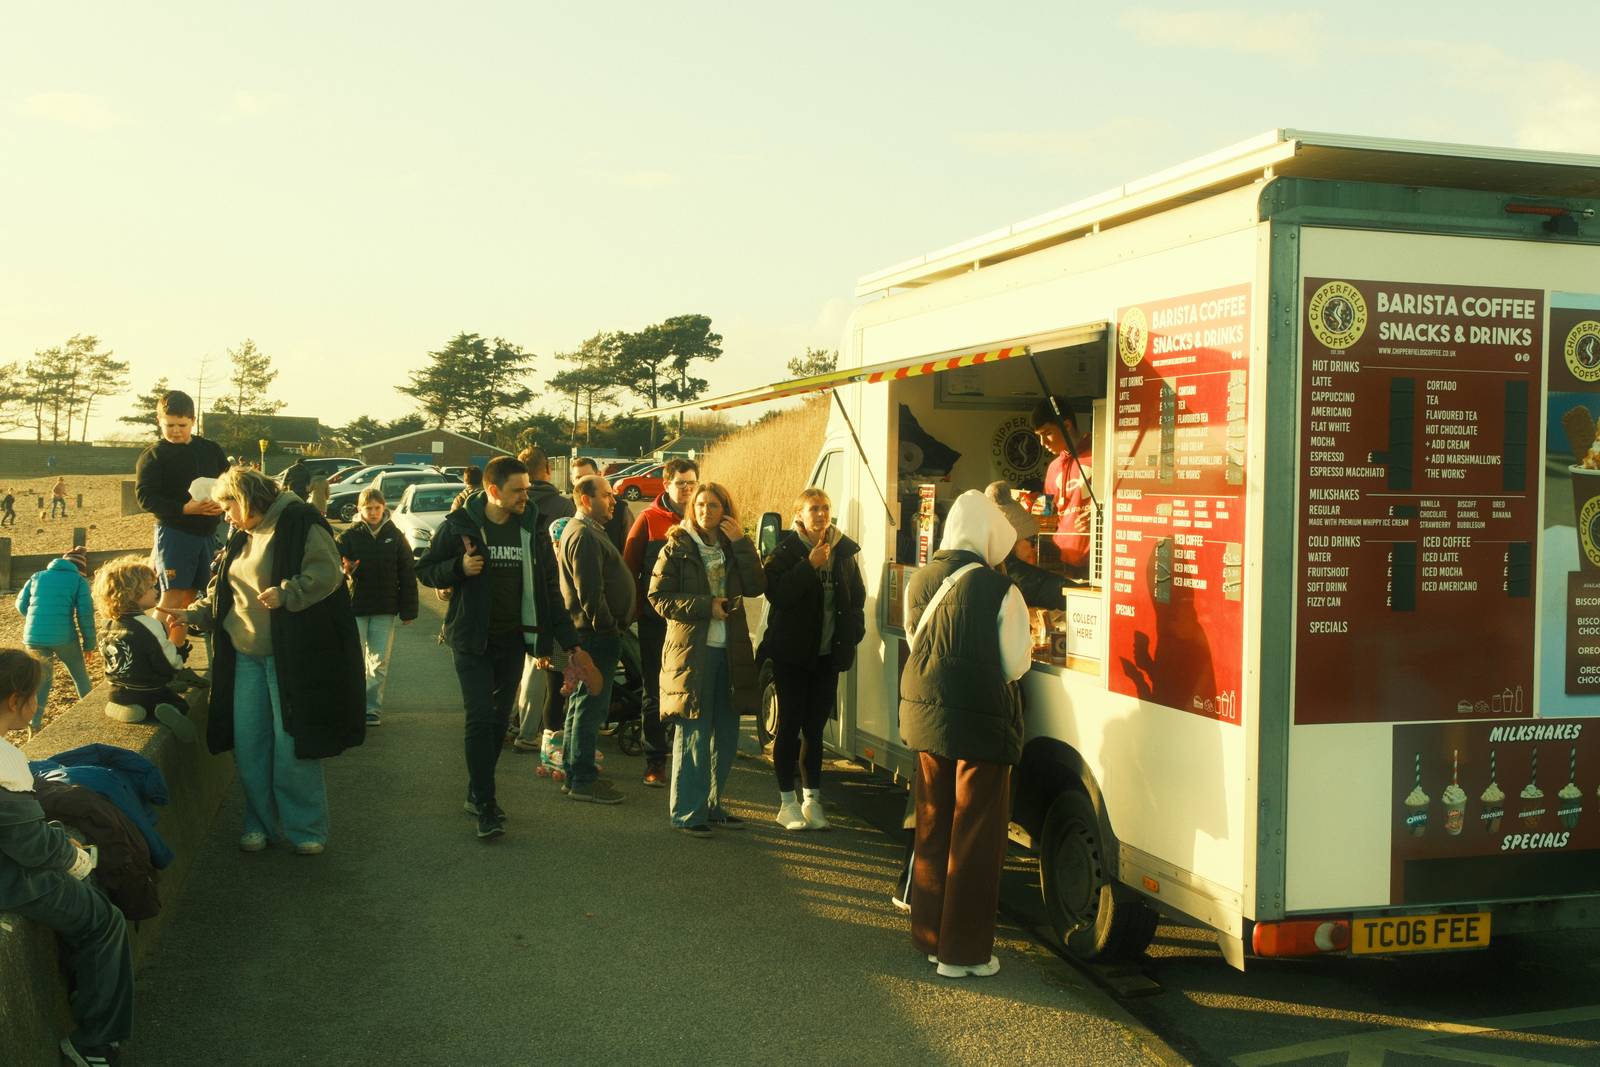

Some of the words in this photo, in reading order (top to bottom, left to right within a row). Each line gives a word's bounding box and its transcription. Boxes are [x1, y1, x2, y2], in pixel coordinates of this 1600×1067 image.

[1377, 292, 1458, 316] BARISTA
[1462, 298, 1535, 320] COFFEE
[1152, 304, 1198, 329] BARISTA
[1199, 295, 1246, 320] COFFEE
[1153, 332, 1193, 354] SNACKS
[1194, 331, 1201, 347] &
[1204, 325, 1244, 347] DRINKS
[1319, 331, 1356, 346] COFFEE
[1379, 322, 1450, 343] SNACKS
[1454, 324, 1466, 343] &
[1470, 326, 1532, 346] DRINKS
[1312, 360, 1328, 371] HOT
[1330, 361, 1360, 372] DRINKS
[1312, 376, 1332, 387] LATTE
[1426, 380, 1456, 391] CORTADO
[1312, 391, 1355, 403] CAPPUCCINO
[1426, 395, 1439, 405] TEA
[1311, 407, 1352, 418] AMERICANO
[1426, 410, 1463, 420] FLAVOURED
[1465, 411, 1478, 421] TEA
[1311, 422, 1325, 432] FLAT
[1327, 422, 1350, 432] WHITE
[1426, 425, 1439, 435] HOT
[1440, 425, 1478, 436] CHOCOLATE
[1310, 437, 1335, 447] MOCHA
[1432, 440, 1445, 449] ADD
[1446, 440, 1470, 450] CREAM
[1310, 452, 1344, 462] ESPRESSO
[1367, 452, 1372, 463] £
[1431, 454, 1445, 464] ADD
[1446, 455, 1500, 465] MARSHMALLOWS
[1310, 467, 1344, 477] ESPRESSO
[1346, 467, 1384, 478] MACCHIATO
[1310, 489, 1359, 500] MILKSHAKES
[1309, 506, 1340, 515] REGULAR
[1389, 506, 1393, 516] £
[1392, 519, 1408, 527] CREAM
[1457, 521, 1485, 529] BUBBLEGUM
[1186, 534, 1203, 547] COFFEE
[1308, 536, 1329, 547] COLD
[1331, 536, 1360, 547] DRINKS
[1423, 537, 1441, 547] ICED
[1442, 537, 1471, 548] COFFEE
[1308, 553, 1331, 562] WATER
[1388, 553, 1392, 562] £
[1423, 553, 1437, 562] ICED
[1439, 553, 1459, 562] LATTE
[1504, 553, 1508, 562] £
[1308, 567, 1349, 577] FRUITSHOOT
[1387, 568, 1392, 577] £
[1422, 567, 1437, 576] ICED
[1439, 567, 1463, 577] MOCHA
[1504, 567, 1508, 577] £
[1307, 582, 1324, 592] SOFT
[1325, 582, 1347, 592] DRINK
[1387, 582, 1392, 592] £
[1422, 582, 1437, 591] ICED
[1438, 582, 1477, 591] AMERICANO
[1503, 582, 1508, 591] £
[1307, 597, 1324, 607] FIZZY
[1326, 597, 1341, 607] CAN
[1386, 597, 1391, 607] £
[1072, 612, 1098, 625] COLLECT
[1310, 622, 1348, 633] SPECIALS
[1076, 627, 1093, 640] HERE
[1489, 724, 1582, 742] MILKSHAKES
[1501, 832, 1570, 851] SPECIALS
[1363, 919, 1426, 948] TC06
[1433, 917, 1480, 944] FEE
